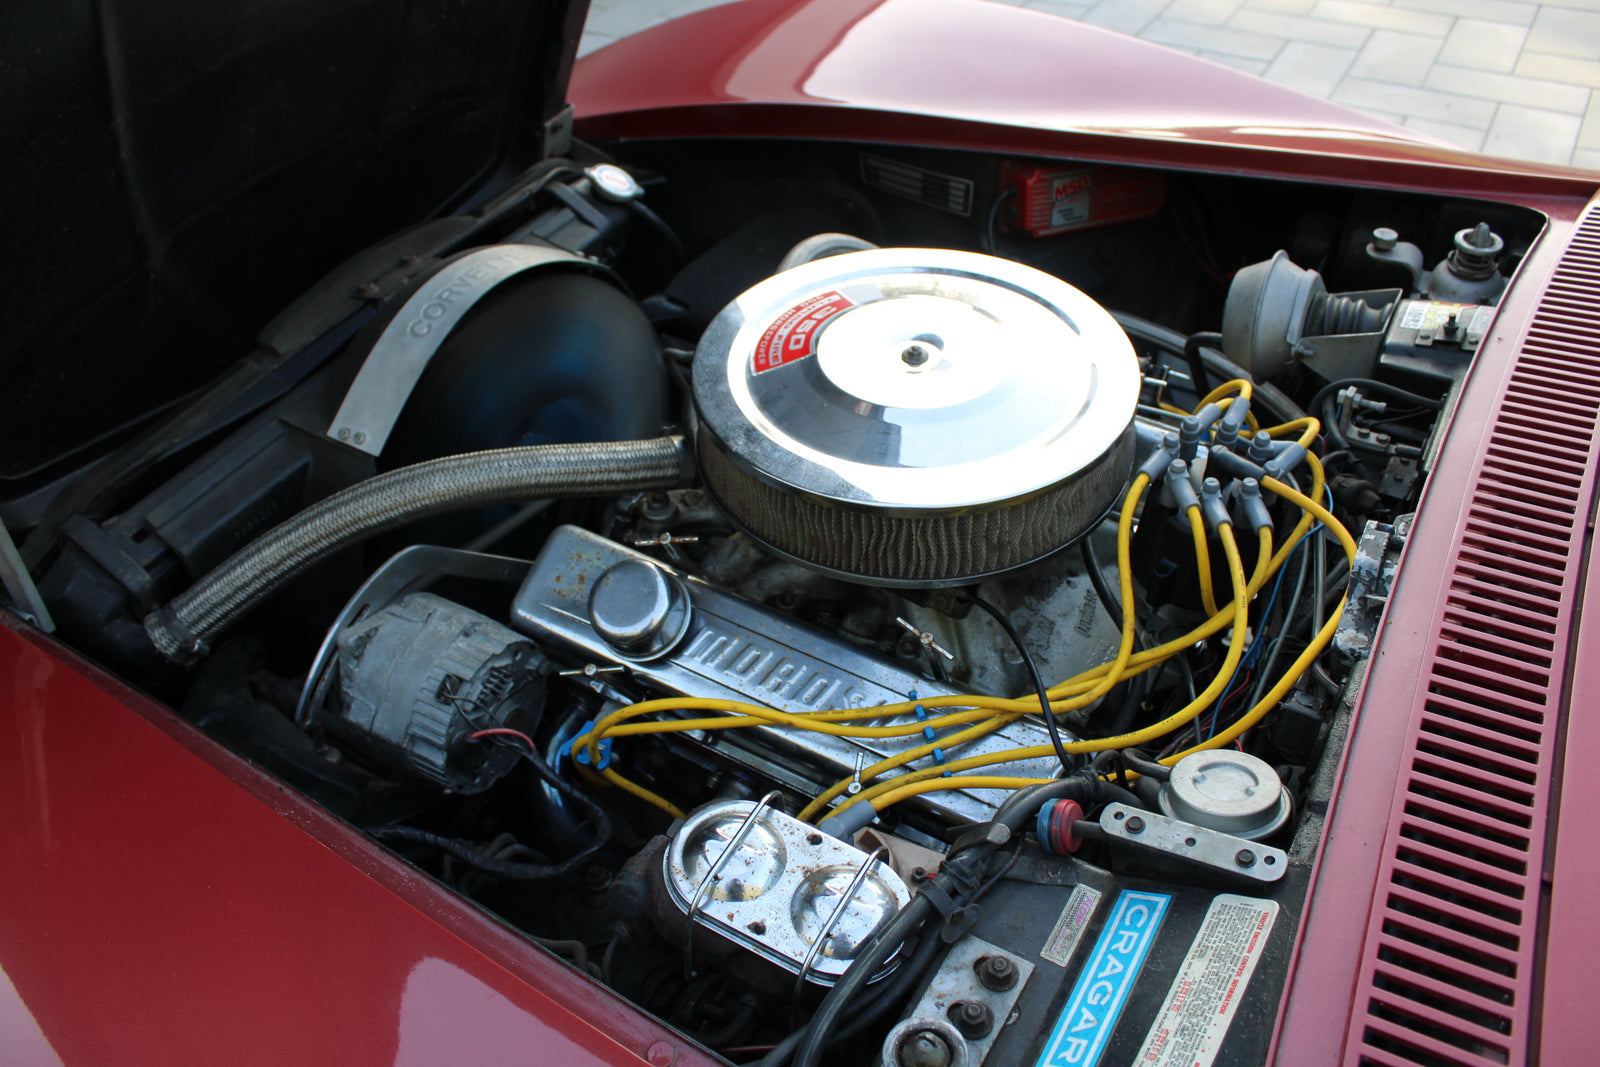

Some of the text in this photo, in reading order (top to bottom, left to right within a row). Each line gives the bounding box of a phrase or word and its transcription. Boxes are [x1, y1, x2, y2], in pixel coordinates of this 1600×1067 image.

[1054, 174, 1089, 201] MSD
[758, 308, 797, 365] HORSEPOWER
[788, 305, 838, 351] 350
[1246, 931, 1260, 953] EMISSION
[1057, 904, 1149, 1064] CRAGAR
[1235, 955, 1250, 977] CONTROL
[1218, 978, 1239, 1014] INFORMATION
